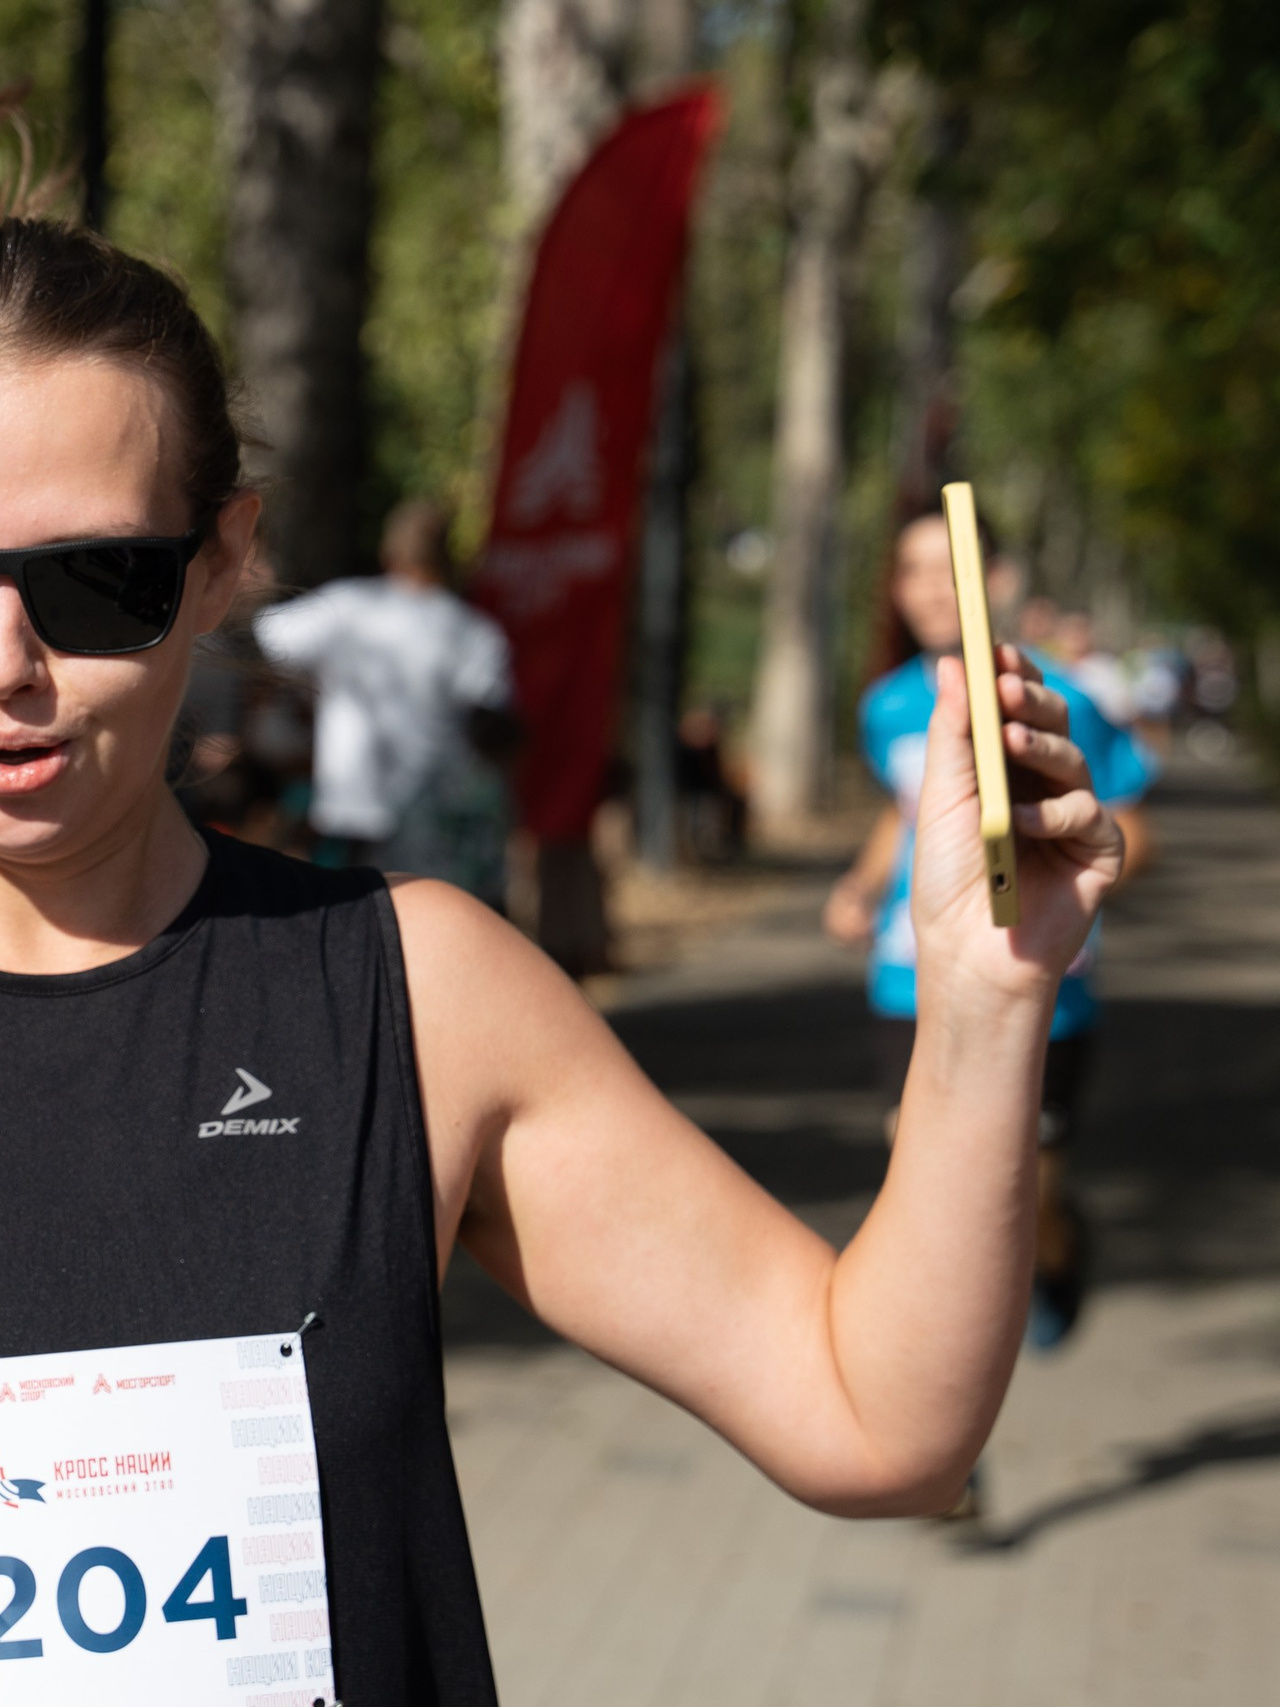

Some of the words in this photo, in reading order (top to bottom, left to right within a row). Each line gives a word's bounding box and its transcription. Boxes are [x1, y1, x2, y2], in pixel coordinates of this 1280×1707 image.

[198, 1117, 301, 1138] DEMIX
[54, 1457, 109, 1480] КРОСС
[115, 1451, 171, 1475] НАЦИИ
